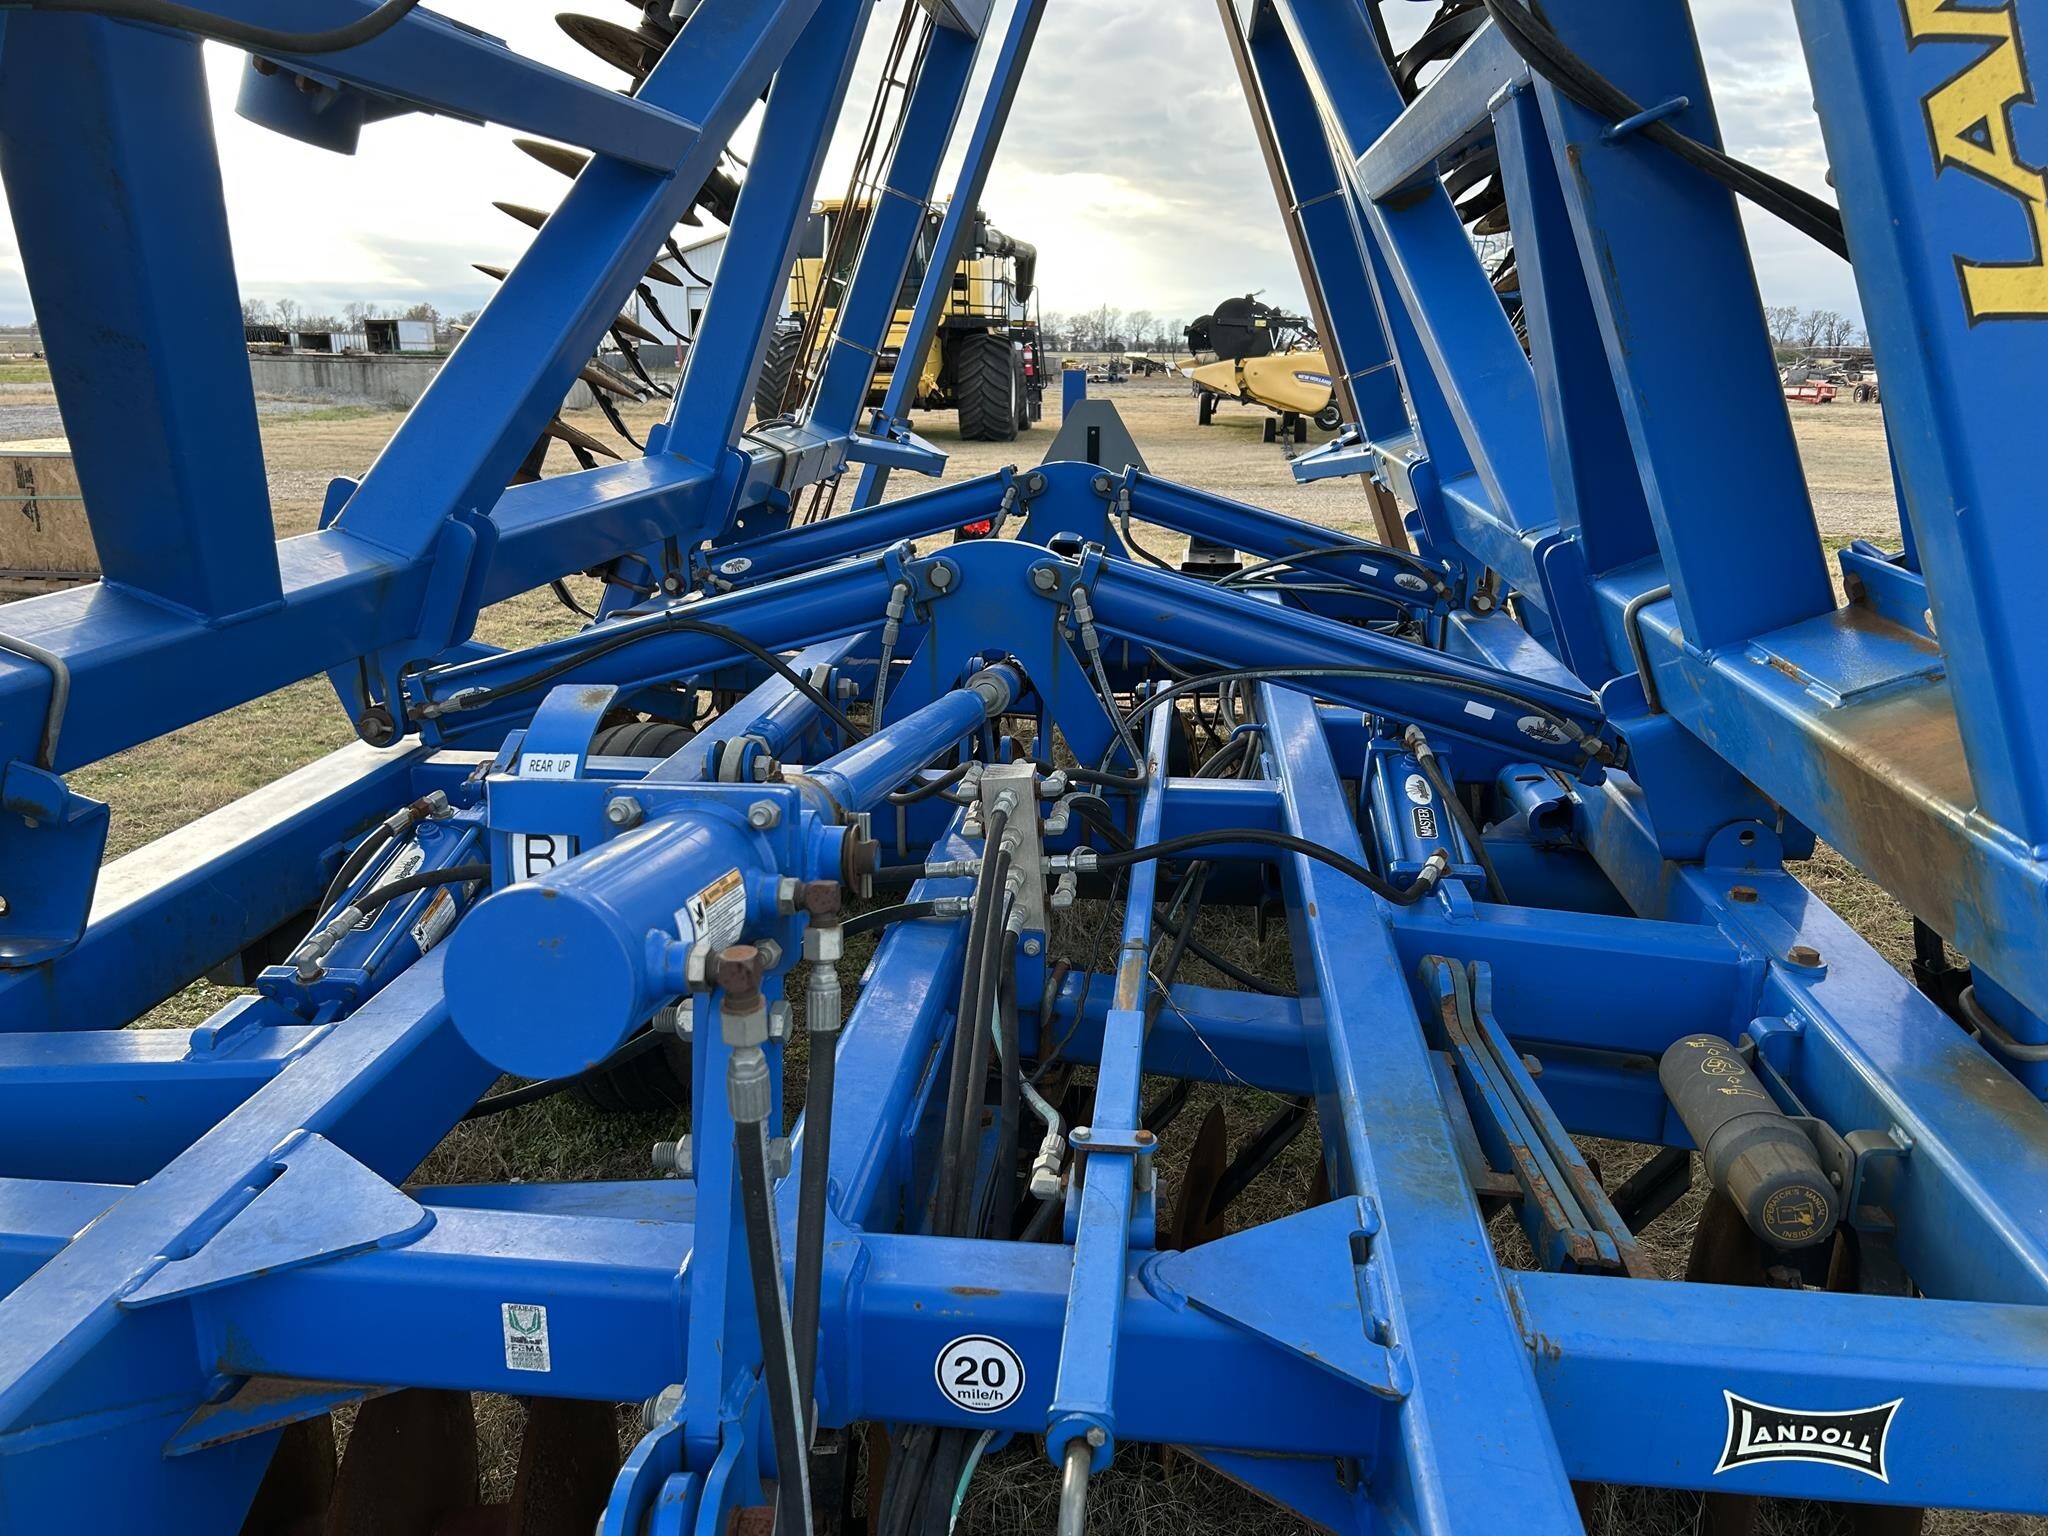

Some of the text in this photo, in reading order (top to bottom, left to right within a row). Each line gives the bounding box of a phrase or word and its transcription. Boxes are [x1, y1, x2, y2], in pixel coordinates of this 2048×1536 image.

[529, 759, 571, 773] REAR UP
[1418, 809, 1433, 836] MASTER
[1782, 1226, 1815, 1238] INSIDE
[511, 1344, 543, 1353] FEMA
[954, 1356, 1006, 1388] 20
[957, 1389, 1003, 1400] mile/h
[1736, 1409, 1872, 1463] LANDOLL
